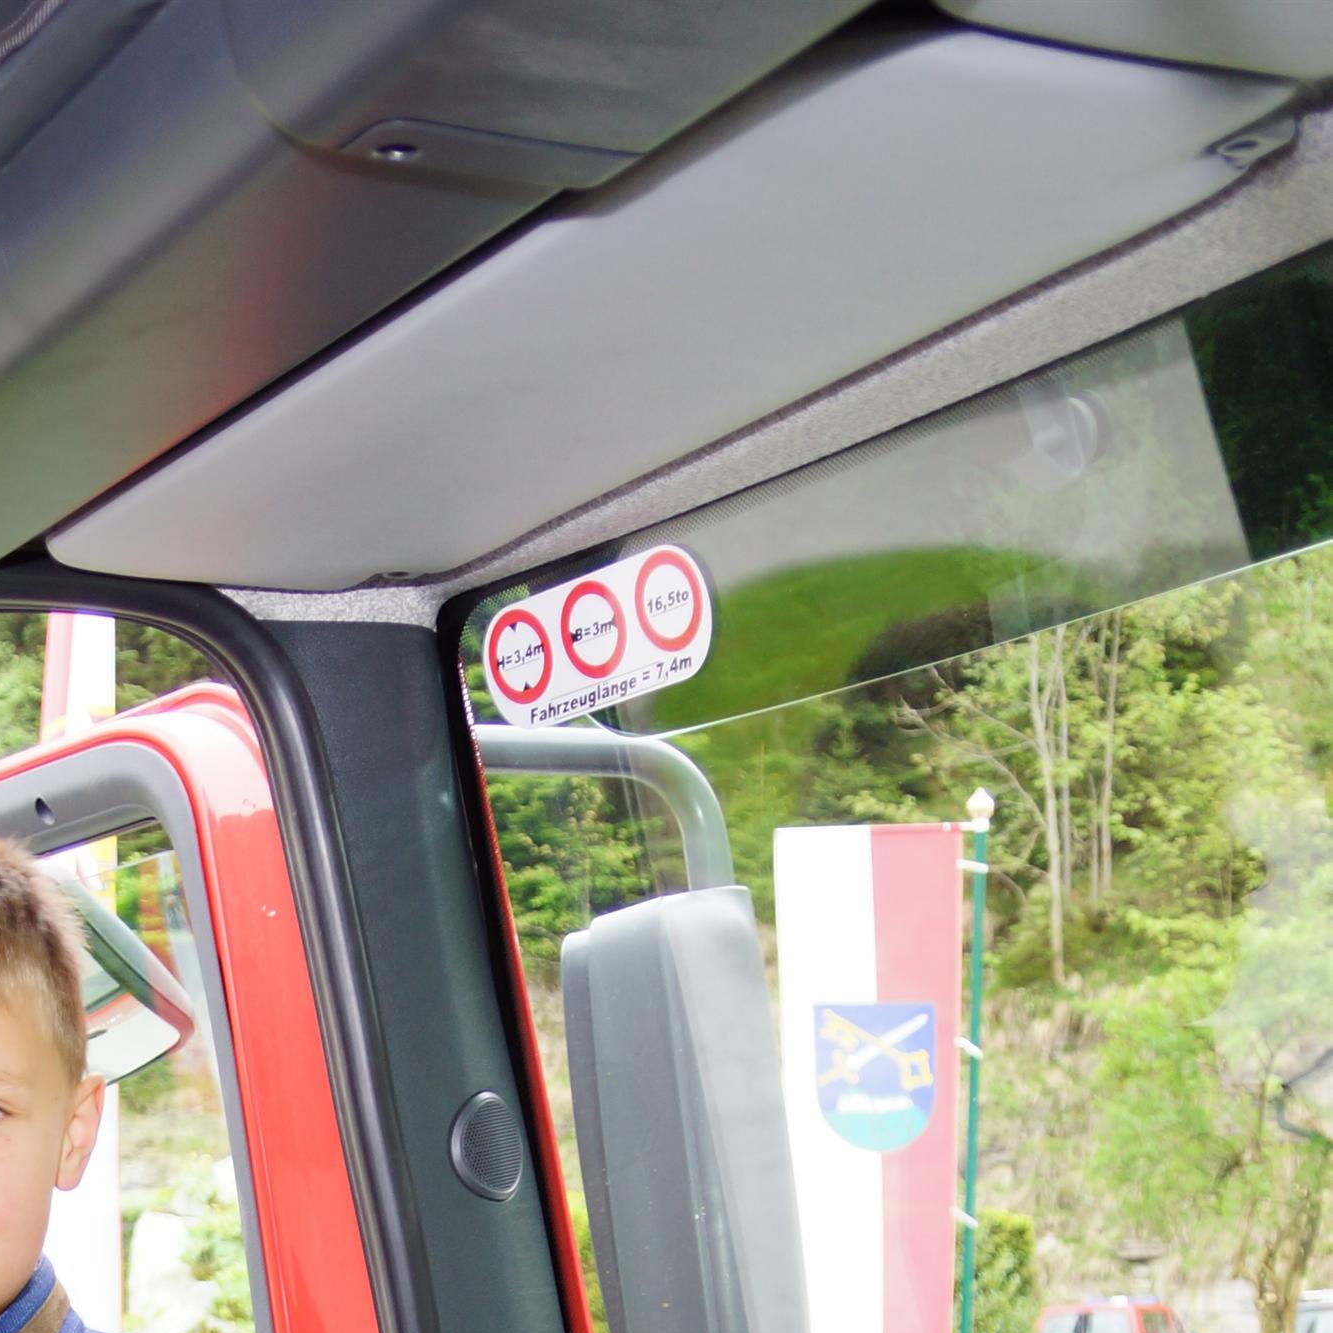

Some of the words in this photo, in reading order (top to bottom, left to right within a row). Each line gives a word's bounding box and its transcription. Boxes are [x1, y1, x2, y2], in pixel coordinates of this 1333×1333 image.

[647, 590, 689, 614] 16,5to
[497, 643, 544, 670] H=3,4m
[530, 676, 637, 724] Fahrzeuglänge
[656, 655, 693, 681] 7,4m
